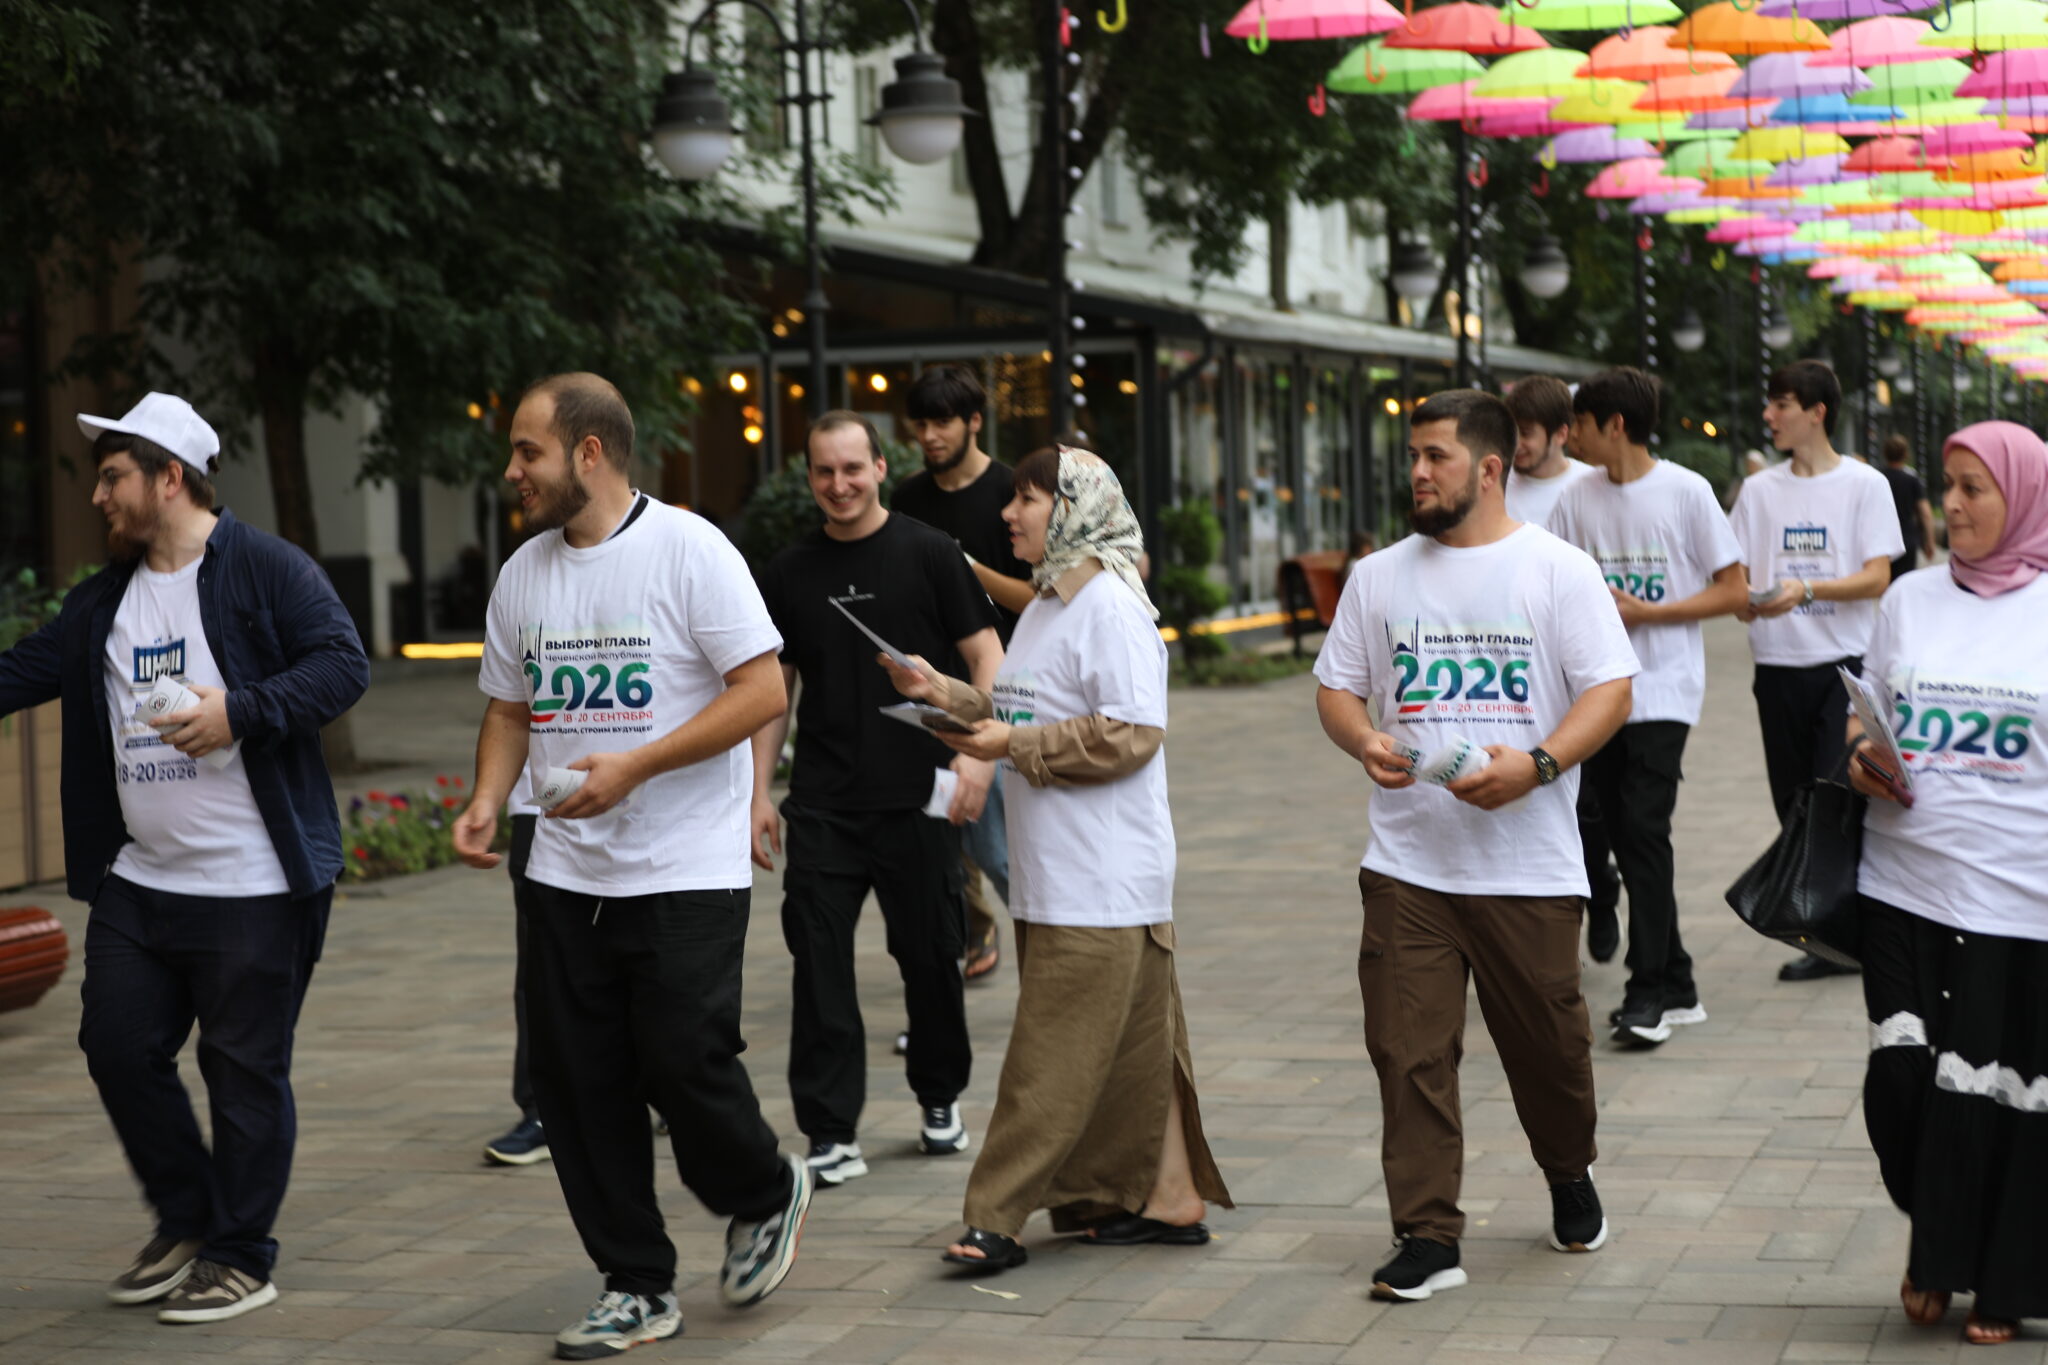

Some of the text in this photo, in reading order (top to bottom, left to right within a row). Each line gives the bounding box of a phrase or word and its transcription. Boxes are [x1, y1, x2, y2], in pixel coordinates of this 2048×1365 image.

[545, 636, 651, 651] ВЫБОРЫ ГЛАВЫ
[1424, 634, 1533, 646] ВЫБОРЫ ГЛАВЫ
[545, 652, 597, 663] Чеченской
[1424, 646, 1475, 656] Чеченской
[523, 661, 653, 712] 2026
[1392, 657, 1531, 703] 2026
[1457, 703, 1471, 713] 20
[1476, 703, 1534, 714] СЕНТЯБРЯ
[578, 713, 588, 723] 20
[592, 711, 653, 723] СЕНТЯБРЯ
[1895, 703, 2032, 760] 2026
[158, 766, 197, 780] 2026
